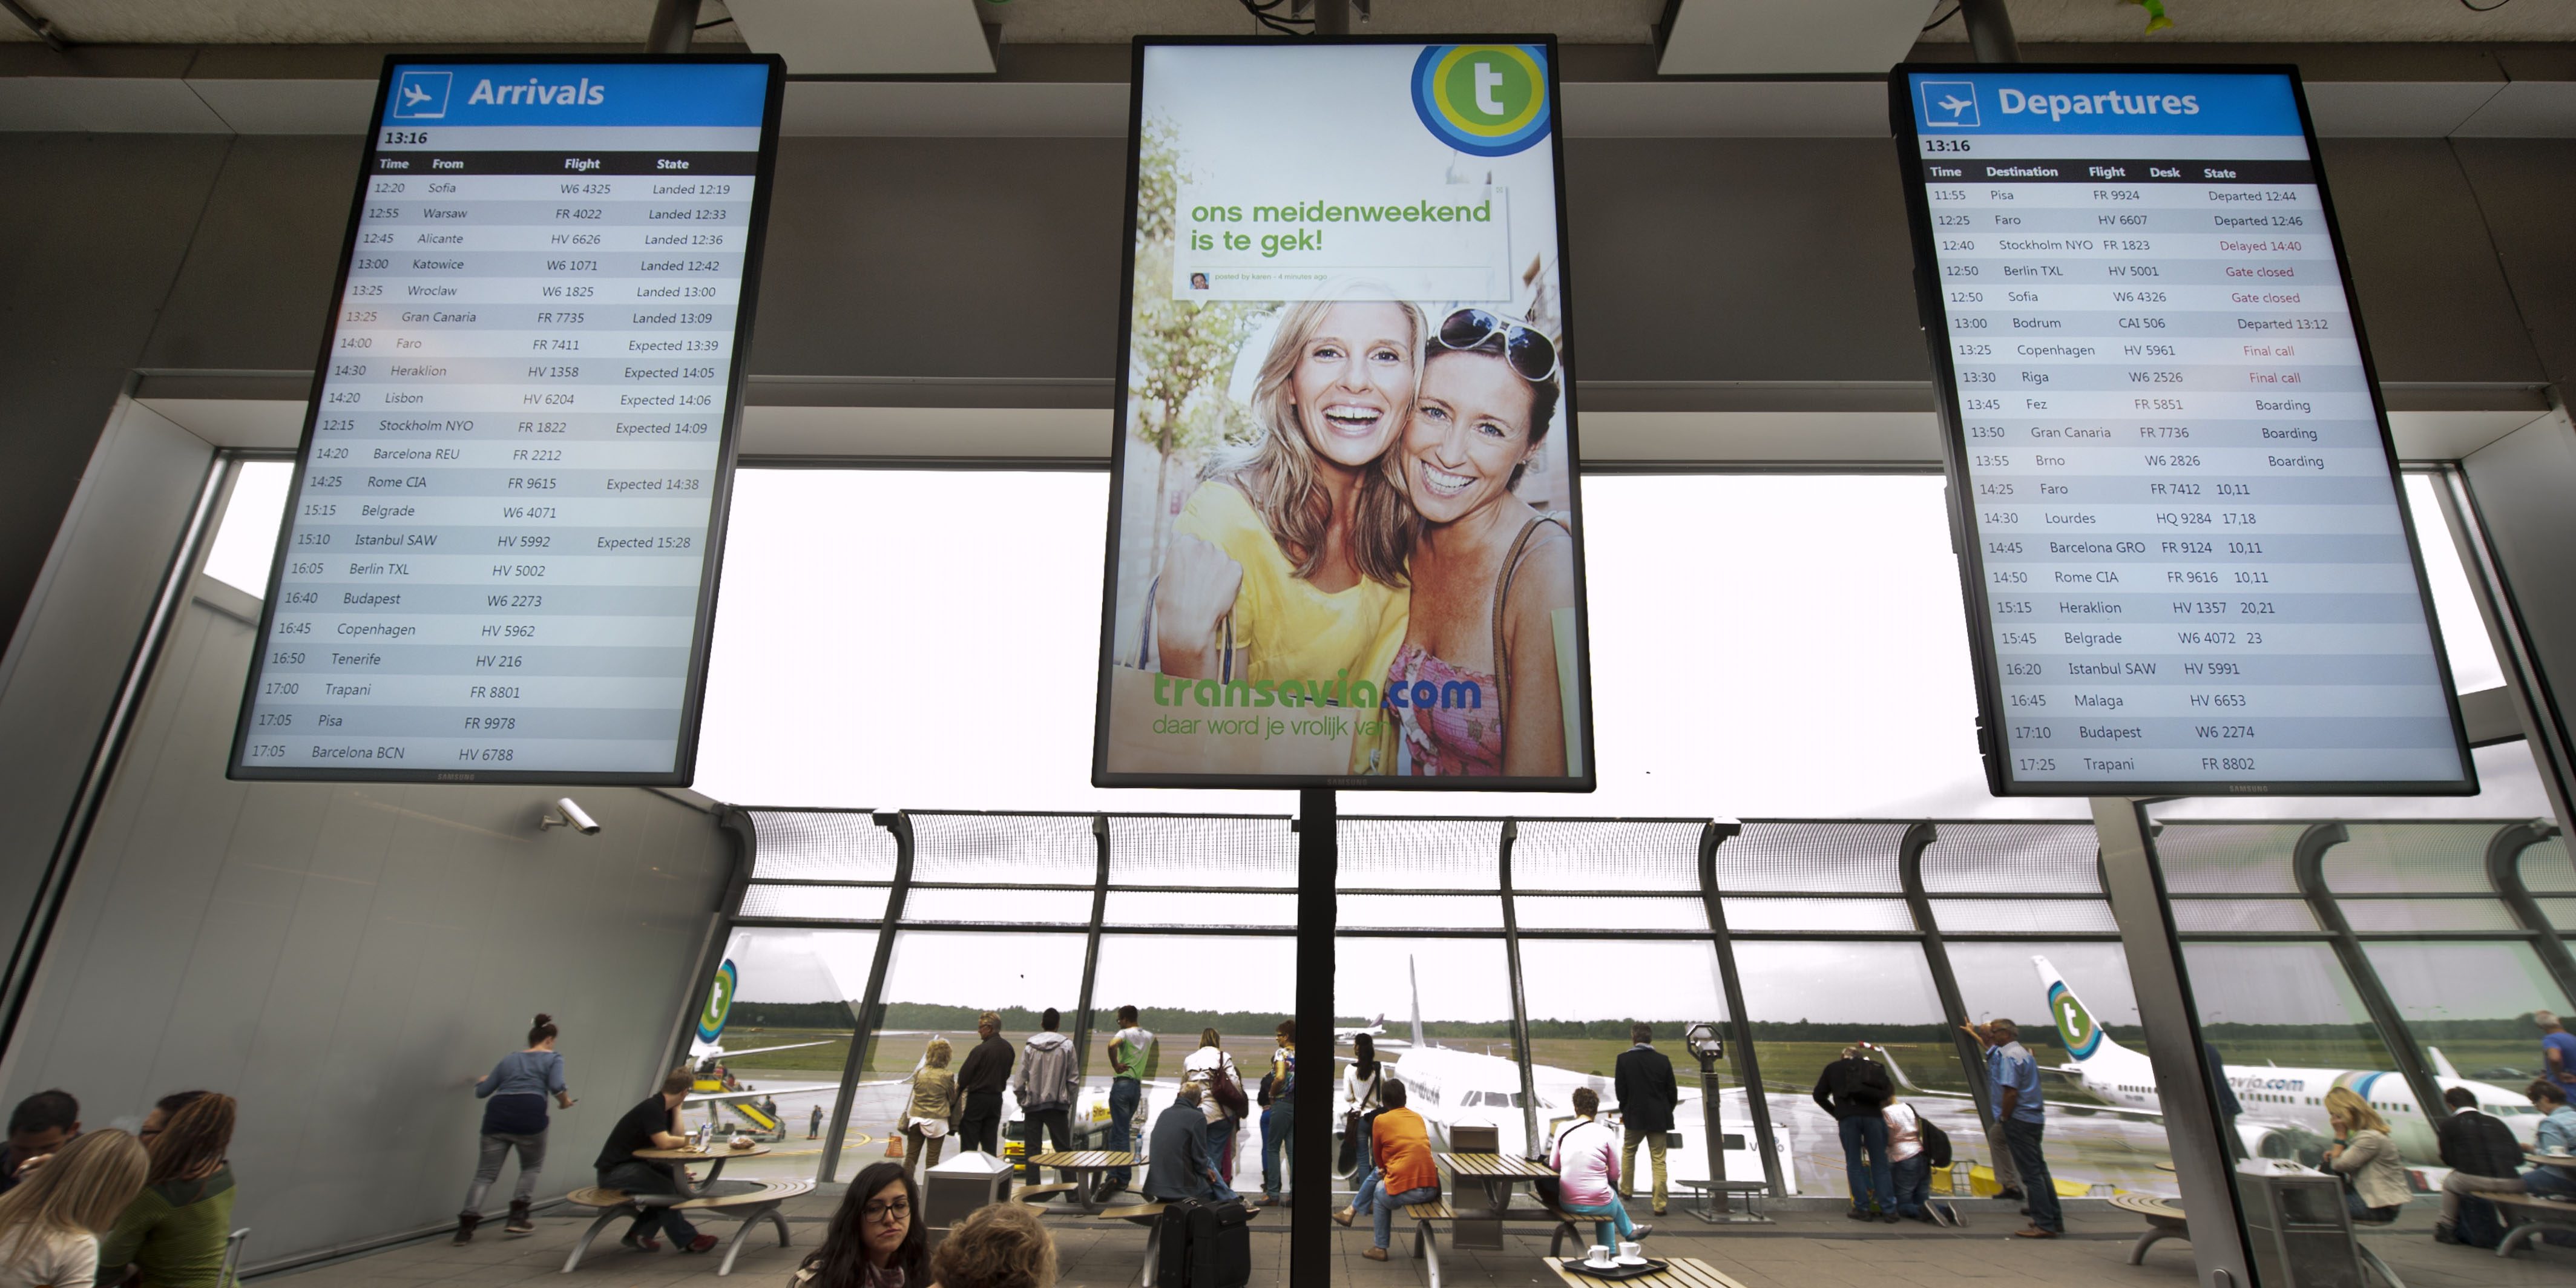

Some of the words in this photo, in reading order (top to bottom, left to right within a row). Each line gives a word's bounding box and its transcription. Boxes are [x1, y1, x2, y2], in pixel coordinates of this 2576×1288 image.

[468, 77, 605, 105] Arrivals
[1474, 62, 1504, 116] t
[1999, 88, 2200, 122] Departures
[384, 132, 428, 144] 13:16
[1925, 140, 1971, 152] 13:16
[380, 158, 410, 169] Time
[432, 159, 464, 169] From
[564, 158, 601, 172] Flight
[656, 159, 689, 169] State
[1930, 166, 1962, 177] Time
[1986, 166, 2059, 178] Destination
[2089, 166, 2126, 180] Flight
[2149, 167, 2181, 177] Desk
[2204, 168, 2236, 179] State
[374, 183, 405, 193] 12:20
[428, 182, 456, 193] Sofia
[560, 184, 580, 194] W6
[582, 184, 611, 194] 4325
[652, 184, 696, 194] Landed
[699, 184, 731, 195] 12:19
[1191, 203, 1243, 223] ons
[1252, 199, 1491, 223] meidenweekend
[1938, 215, 1970, 226] 12:25
[1995, 215, 2021, 225] Faro
[2098, 215, 2116, 225] HV
[2119, 215, 2147, 225] 6607
[2213, 215, 2269, 229] Departed
[2271, 216, 2303, 226] 12:46
[363, 233, 394, 243] 12:45
[417, 233, 464, 244] Alicante
[551, 234, 570, 245] HV
[572, 234, 601, 245] 6626
[645, 234, 688, 245] Landed
[691, 234, 723, 245] 12:36
[1191, 229, 1214, 251] is
[1223, 230, 1251, 251] te
[1261, 229, 1322, 258] gek!
[1947, 266, 1979, 276] 12:50
[2003, 265, 2038, 276] Berlin
[2040, 266, 2063, 276] TXL
[2108, 266, 2126, 276] HV
[2130, 266, 2160, 277] 5001
[2226, 266, 2253, 277] Gate
[2256, 267, 2295, 277] closed
[352, 285, 383, 296] 13:25
[408, 285, 458, 296] Wroclaw
[542, 286, 562, 297] W6
[565, 286, 594, 297] 1825
[637, 286, 681, 297] Landed
[684, 286, 716, 297] 13:00
[1954, 318, 1988, 329] 13:00
[2012, 317, 2062, 328] Bodrum
[2118, 318, 2141, 329] CAI
[2143, 318, 2166, 329] 506
[2237, 318, 2293, 332] Departed
[2296, 319, 2328, 330] 13:12
[341, 338, 372, 349] 14:00
[396, 338, 422, 349] Faro
[533, 339, 548, 350] FR
[551, 340, 579, 350] 7411
[628, 340, 683, 353] Expected
[686, 340, 719, 351] 13:39
[1963, 372, 1996, 383] 13:30
[2022, 371, 2049, 386] Riga
[2128, 372, 2150, 383] W6
[2153, 372, 2183, 383] 2526
[2249, 372, 2278, 383] Final
[2281, 372, 2301, 383] call
[329, 392, 361, 403] 14:20
[385, 392, 424, 404] Lisbon
[523, 394, 542, 404] HV
[545, 393, 574, 405] 6204
[620, 394, 675, 409] Expected
[678, 395, 711, 406] 14:06
[1971, 427, 2005, 438] 13:50
[2031, 427, 2061, 438] Gran
[2064, 427, 2111, 438] Canaria
[2140, 427, 2156, 438] FR
[2158, 427, 2189, 438] 7736
[2261, 427, 2318, 442] Boarding
[317, 448, 349, 459] 14:20
[373, 448, 432, 459] Barcelona
[435, 448, 460, 460] REU
[513, 449, 528, 461] FR
[531, 450, 562, 461] 2212
[1980, 484, 2014, 495] 14:25
[2040, 483, 2068, 494] Faro
[2150, 483, 2167, 494] FR
[2169, 484, 2201, 495] 7412
[2216, 484, 2250, 496] 10,11
[304, 504, 337, 516] 15:15
[361, 504, 415, 519] Belgrade
[503, 507, 524, 518] W6
[526, 507, 556, 519] 4071
[1989, 542, 2023, 553] 14:45
[2049, 541, 2112, 553] Barcelona
[2116, 542, 2146, 553] GRO
[2161, 542, 2178, 553] FR
[2181, 542, 2213, 553] 9124
[2228, 542, 2263, 555] 10,11
[291, 562, 324, 574] 16:05
[349, 563, 384, 574] Berlin
[388, 563, 409, 575] TXL
[492, 565, 513, 576] HV
[514, 565, 546, 577] 5002
[1997, 601, 2032, 613] 15:15
[2059, 601, 2122, 614] Heraklion
[2173, 602, 2192, 614] HV
[2196, 602, 2227, 614] 1357
[2240, 602, 2275, 615] 20,21
[278, 622, 312, 634] 16:45
[337, 623, 416, 639] Copenhagen
[481, 625, 502, 637] HV
[504, 625, 535, 637] 5962
[2006, 663, 2042, 675] 16:20
[2068, 662, 2121, 675] Istanbul
[2125, 663, 2156, 675] SAW
[2184, 663, 2203, 675] HV
[2207, 663, 2240, 675] 5991
[265, 682, 299, 695] 17:00
[326, 683, 371, 698] Trapani
[470, 686, 487, 698] FR
[489, 686, 520, 699] 8801
[1153, 669, 1482, 709] transavia.com
[1152, 714, 1201, 735] daar
[1207, 715, 1259, 735] word
[1264, 716, 1284, 740] je
[1290, 715, 1348, 741] vrolijk
[1354, 721, 1392, 737] van
[2016, 726, 2051, 739] 17:10
[2079, 725, 2142, 741] Budapest
[2195, 726, 2219, 738] W6
[2222, 726, 2255, 738] 2274
[252, 745, 286, 757] 17:05
[312, 745, 373, 758] Barcelona
[376, 746, 405, 759] BCN
[459, 748, 479, 761] HV
[482, 749, 514, 761] 6788
[711, 982, 723, 1018] t
[2063, 1002, 2080, 1037] t
